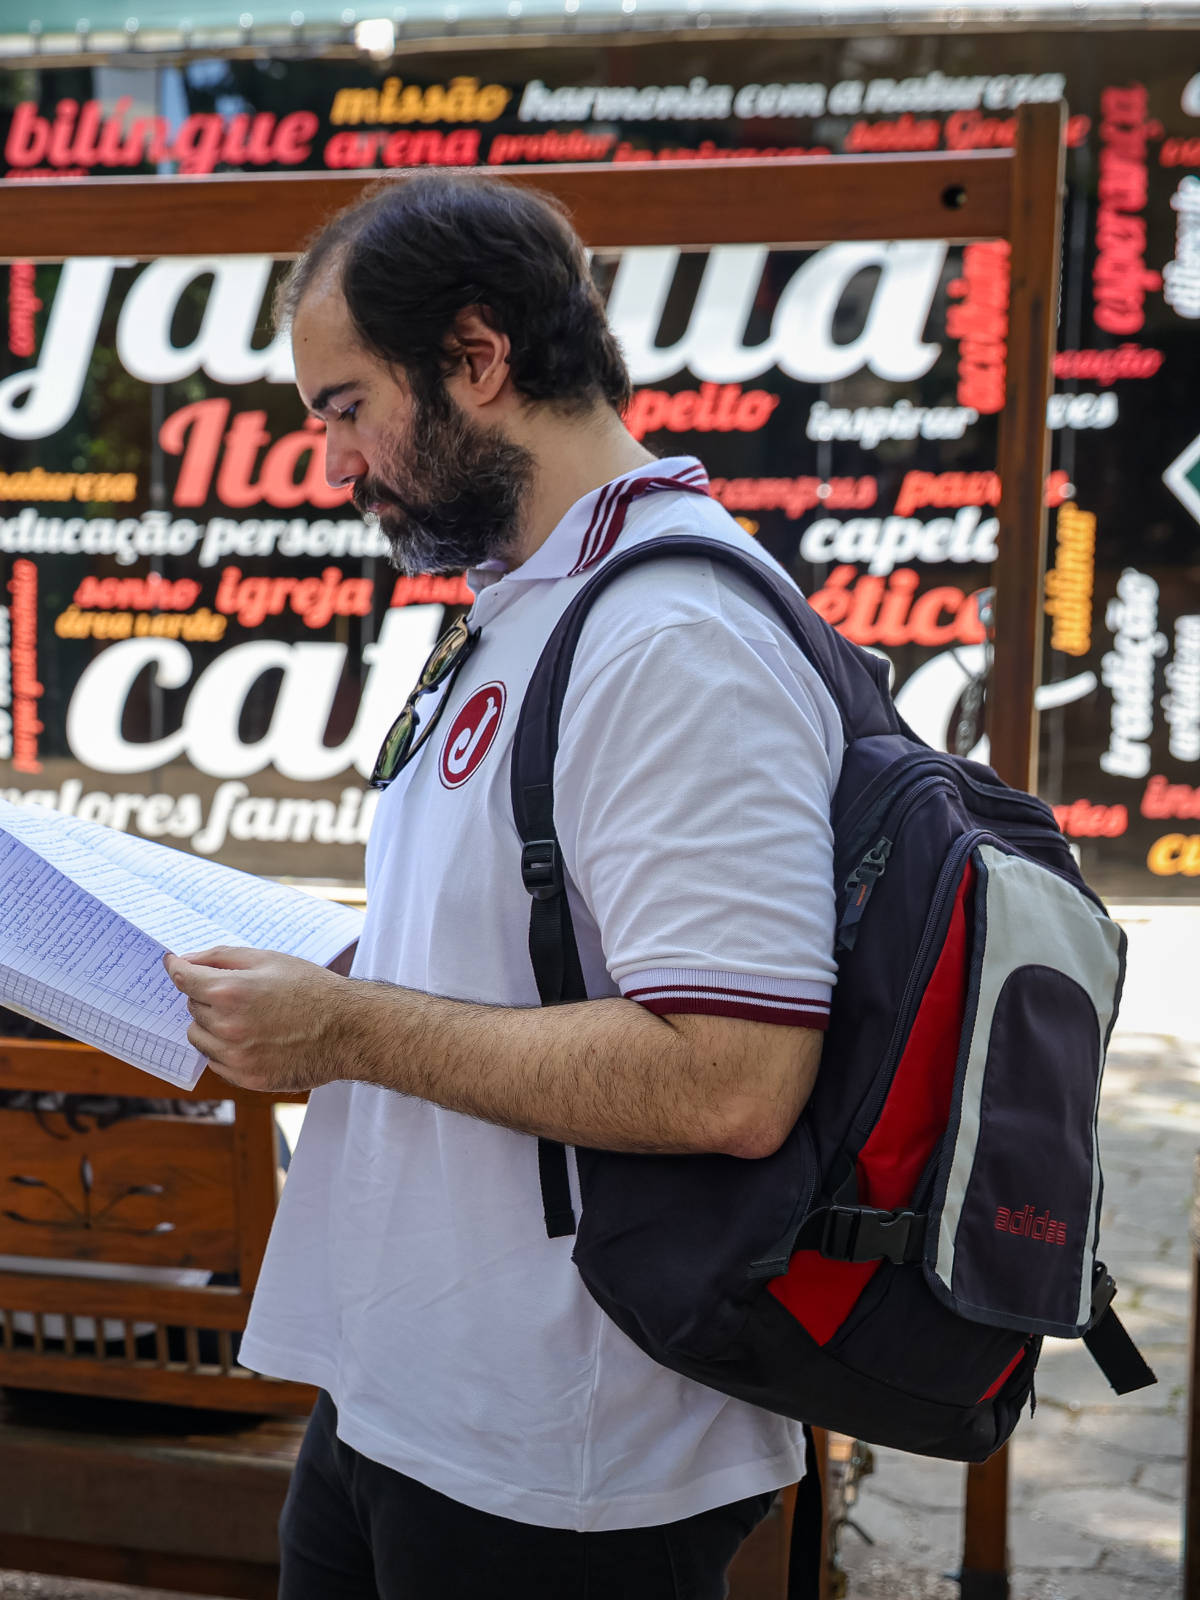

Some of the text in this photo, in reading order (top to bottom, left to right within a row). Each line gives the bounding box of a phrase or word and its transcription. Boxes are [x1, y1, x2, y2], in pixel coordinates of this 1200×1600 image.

[330, 75, 511, 126] missão
[518, 70, 1066, 121] harmonia com a natureza
[4, 96, 318, 176] bilíngue
[324, 128, 481, 169] arena
[806, 400, 978, 450] inspirar
[215, 566, 373, 629] igreja
[1100, 567, 1168, 779] tradição
[995, 1205, 1067, 1246] adidas
